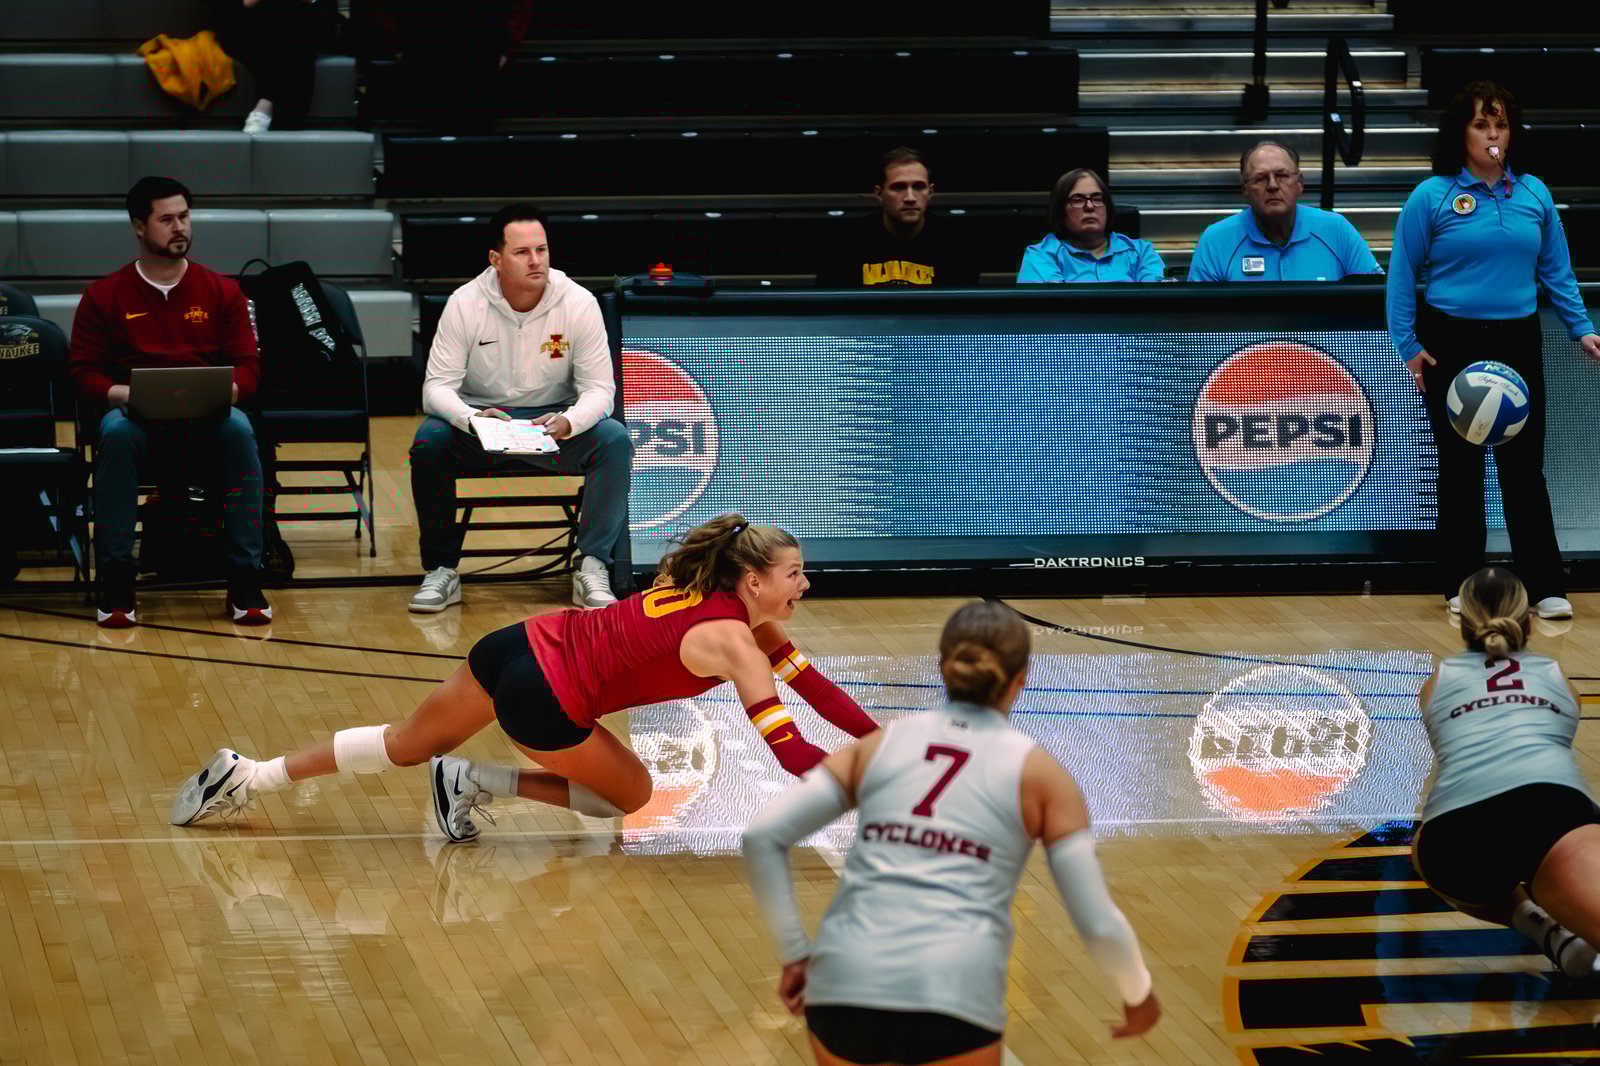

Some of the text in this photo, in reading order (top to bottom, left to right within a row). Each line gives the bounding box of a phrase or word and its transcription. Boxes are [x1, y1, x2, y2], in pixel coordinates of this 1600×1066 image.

[1205, 414, 1362, 450] PEPSI
[1034, 556, 1145, 568] DAKTRONICS
[1485, 656, 1525, 693] 2
[1450, 694, 1561, 720] CYCLONES
[912, 744, 970, 817] 7
[863, 823, 993, 863] CYCLONES
